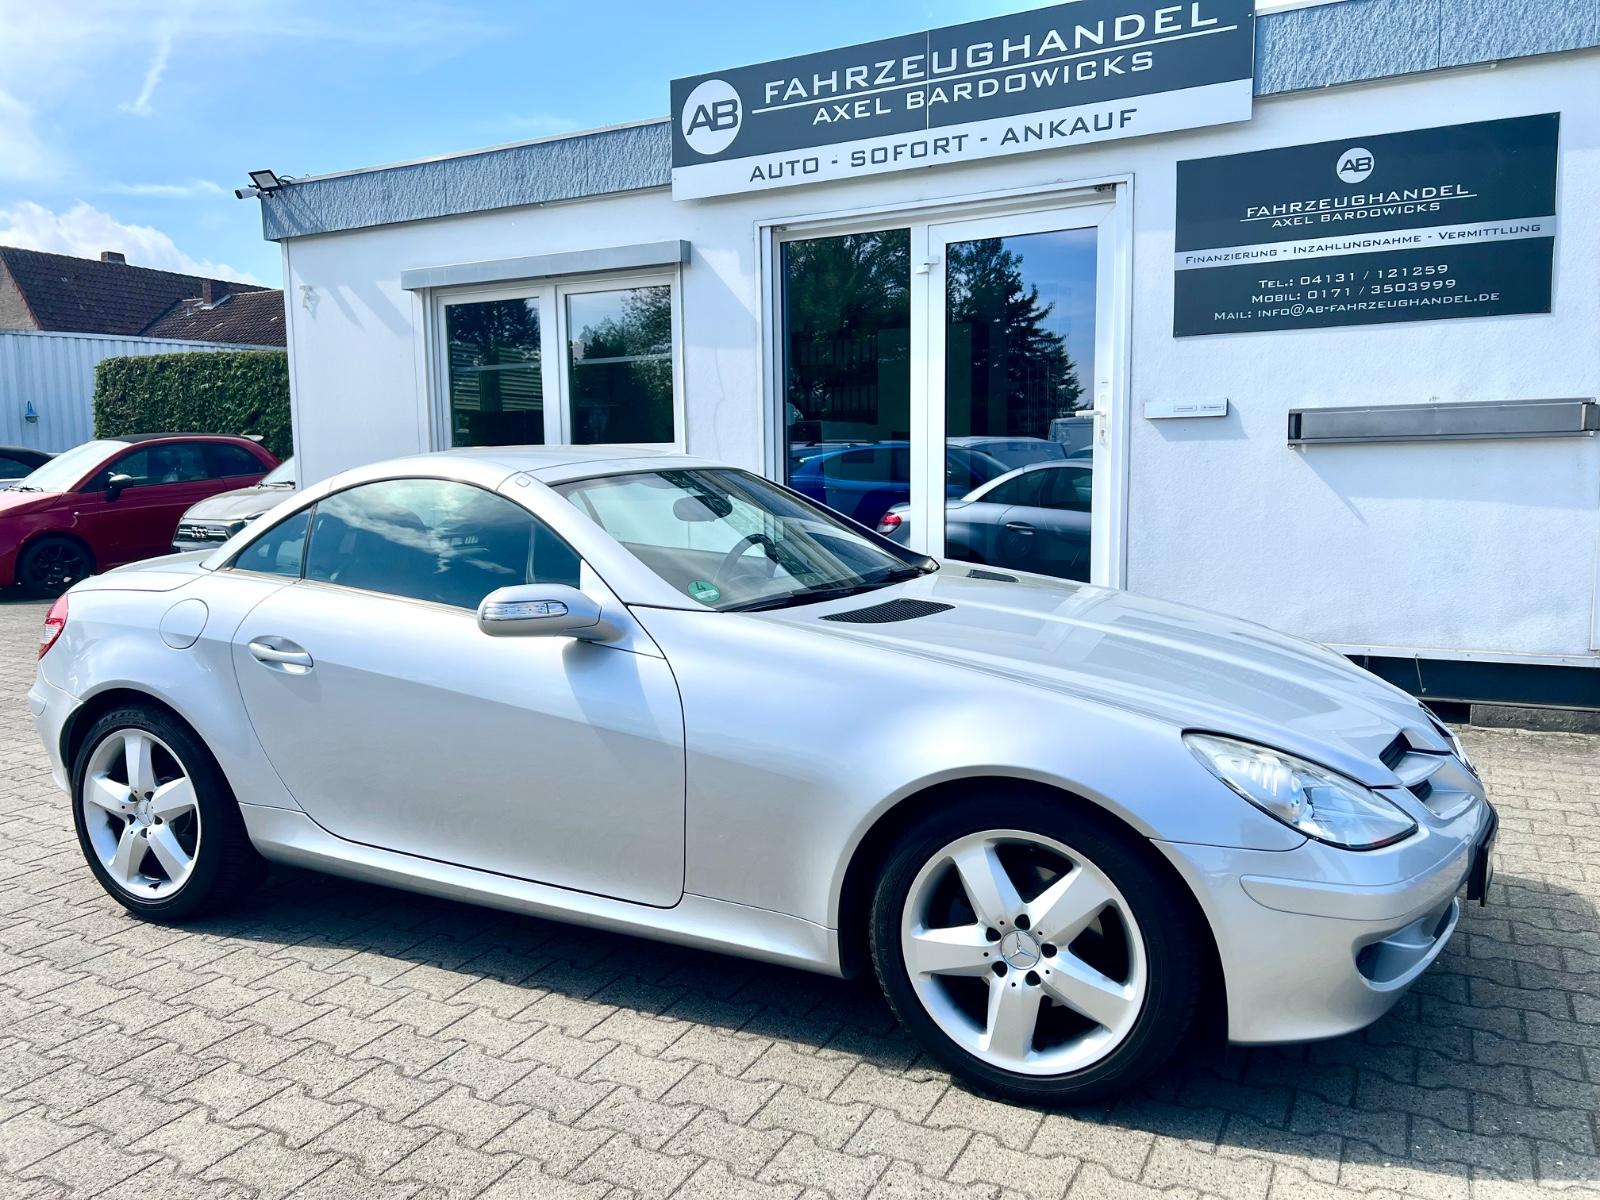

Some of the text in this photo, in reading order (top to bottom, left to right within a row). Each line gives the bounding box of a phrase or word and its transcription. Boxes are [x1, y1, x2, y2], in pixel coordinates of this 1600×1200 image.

[765, 2, 1218, 104] FAHRZEUGHANDEL
[812, 51, 1153, 126] AXEL BARDOWICKS
[686, 98, 739, 136] AB
[749, 157, 819, 182] AUTO
[850, 134, 969, 168] SOFORT
[1000, 108, 1138, 146] ANKAUF
[1339, 156, 1372, 175] AB
[1247, 184, 1469, 218] FAHRZEUGHANDEL
[1271, 202, 1441, 228] AXEL BARDOWICKS
[1300, 272, 1355, 286] 04131
[1377, 264, 1448, 279] 121259
[1307, 287, 1351, 300] 0171
[1370, 279, 1456, 295] 3503999
[695, 581, 706, 591] 4
